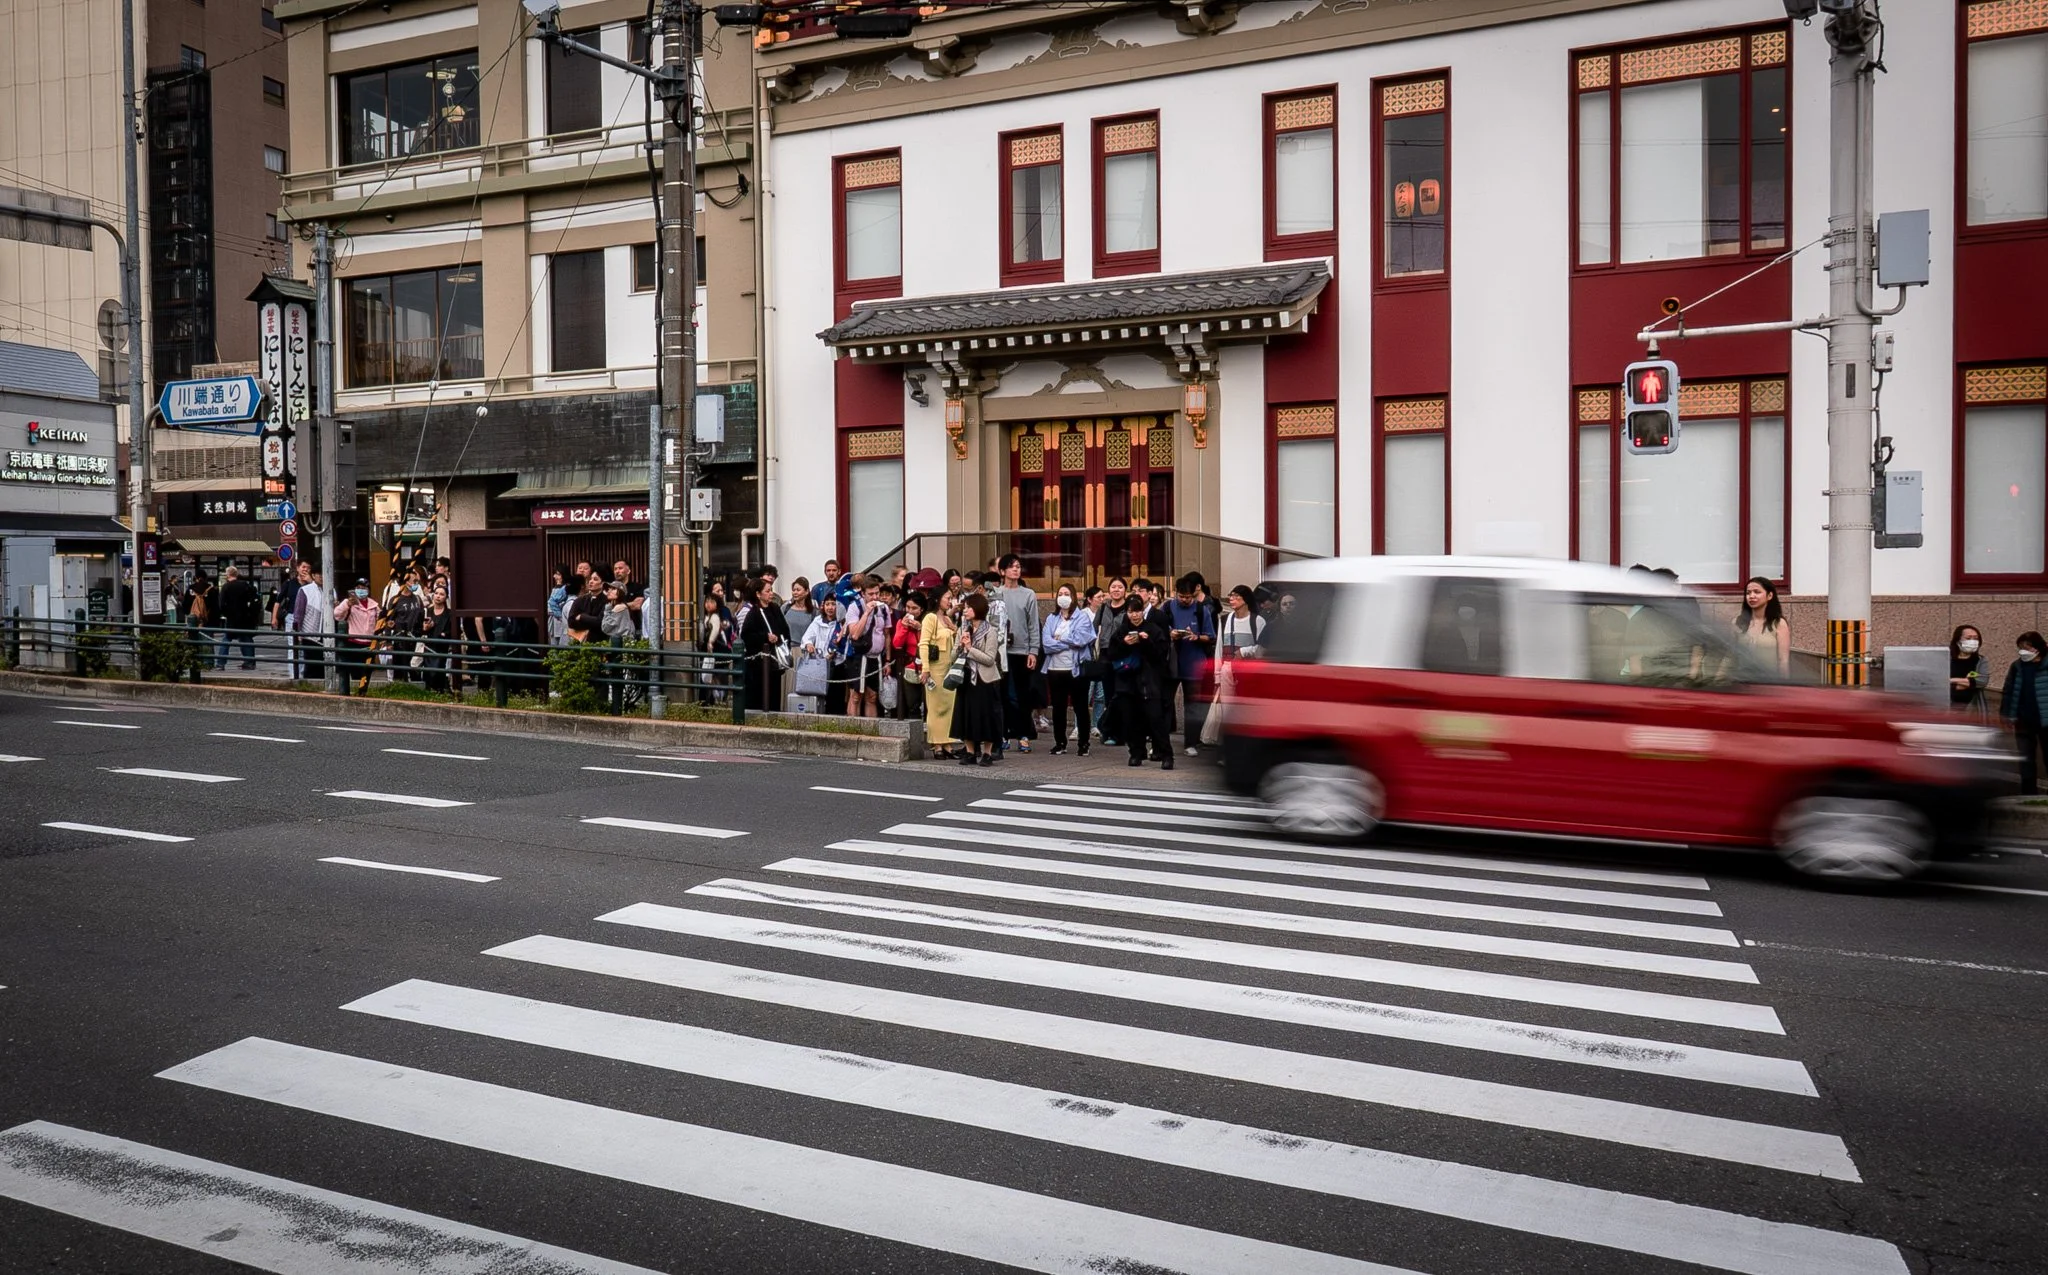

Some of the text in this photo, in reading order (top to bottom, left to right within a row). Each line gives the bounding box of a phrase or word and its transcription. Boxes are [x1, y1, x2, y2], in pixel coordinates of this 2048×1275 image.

[288, 335, 306, 424] にしんそば
[178, 384, 241, 406] 川端通り
[182, 403, 237, 417] Kawabata dori
[39, 427, 88, 443] KEIHAN
[9, 451, 108, 473] 京阪電車 祇園四条駅
[268, 441, 280, 470] 松葉
[1, 469, 116, 486] Keihan Railway Gion-shijo Station
[570, 507, 624, 522] にしんそば
